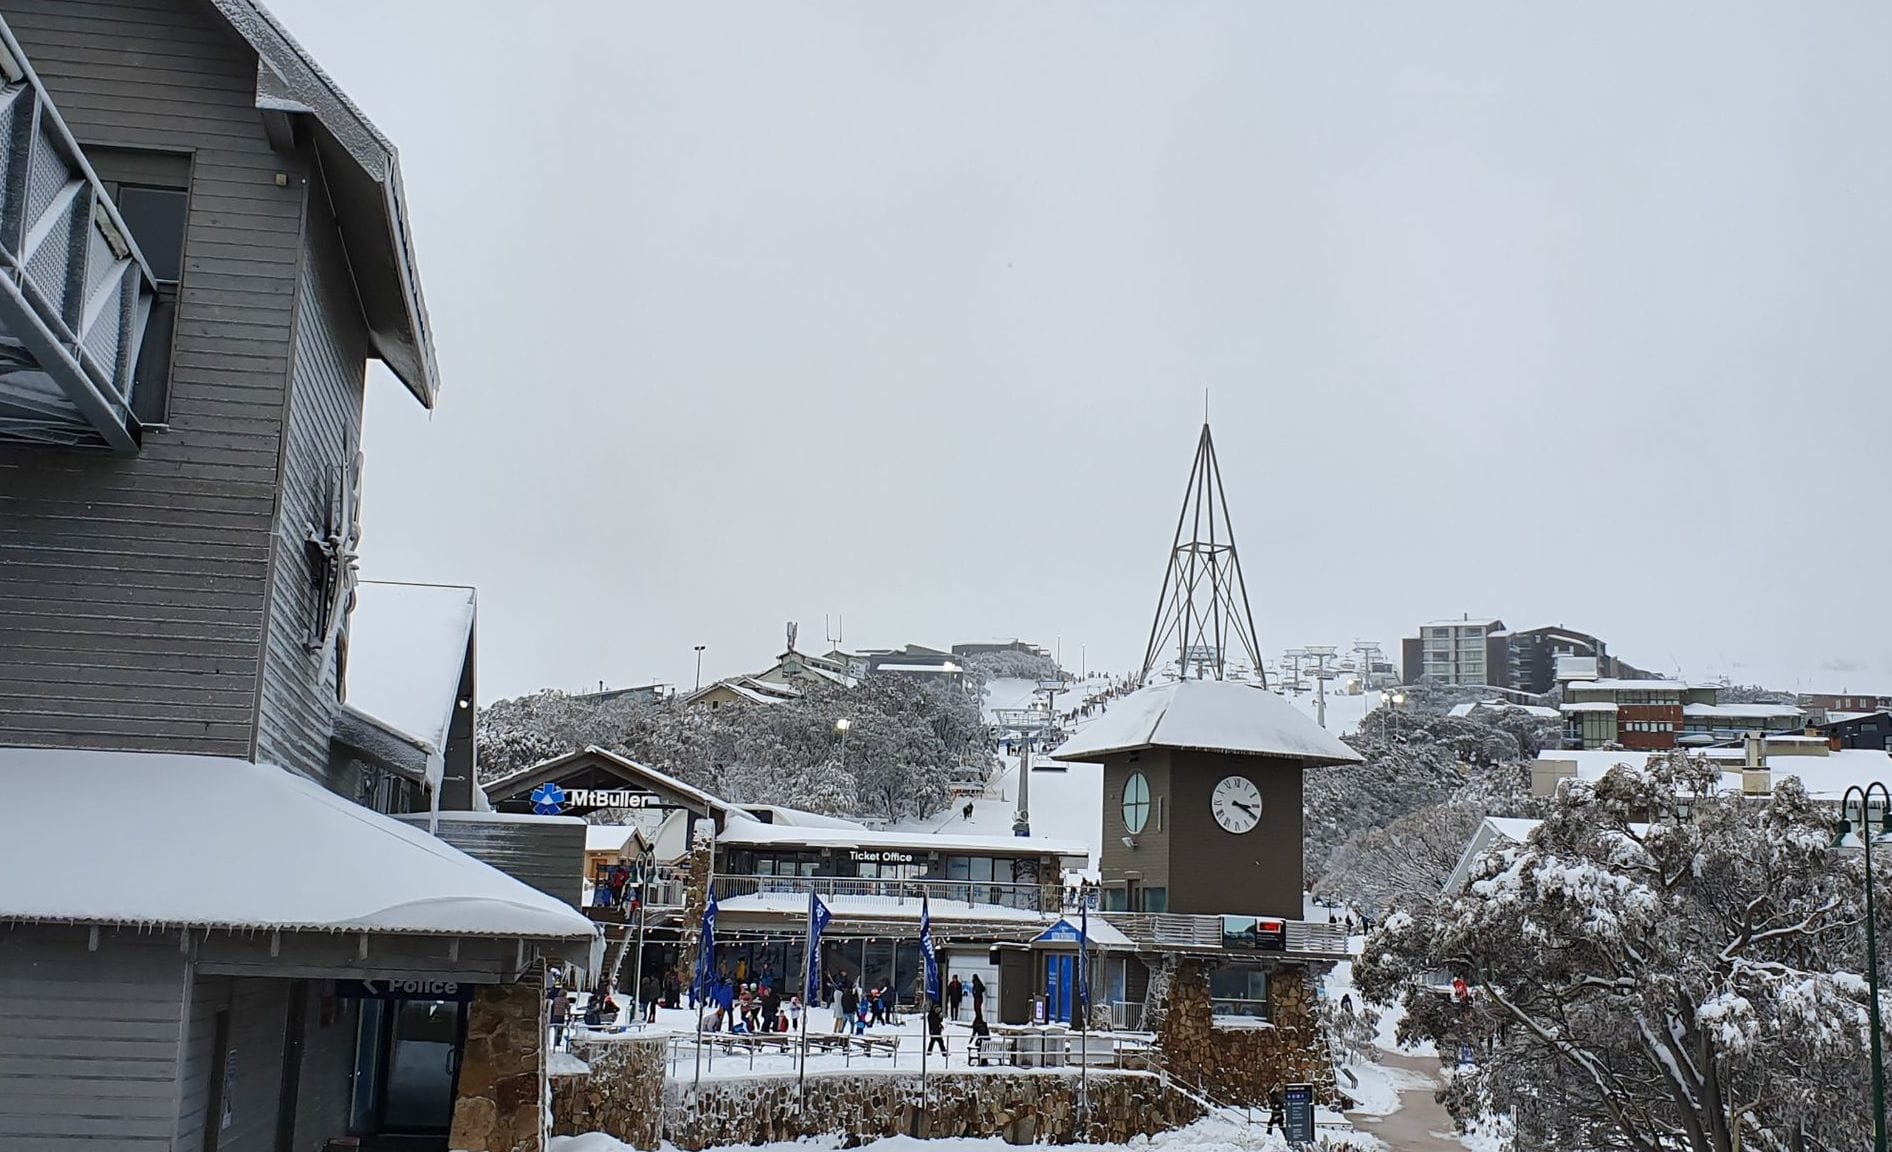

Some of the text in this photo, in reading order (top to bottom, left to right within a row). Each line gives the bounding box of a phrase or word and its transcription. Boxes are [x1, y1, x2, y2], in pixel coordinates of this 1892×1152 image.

[571, 789, 648, 808] MtBuller
[849, 850, 913, 863] Ticket Office
[388, 978, 459, 995] Police
